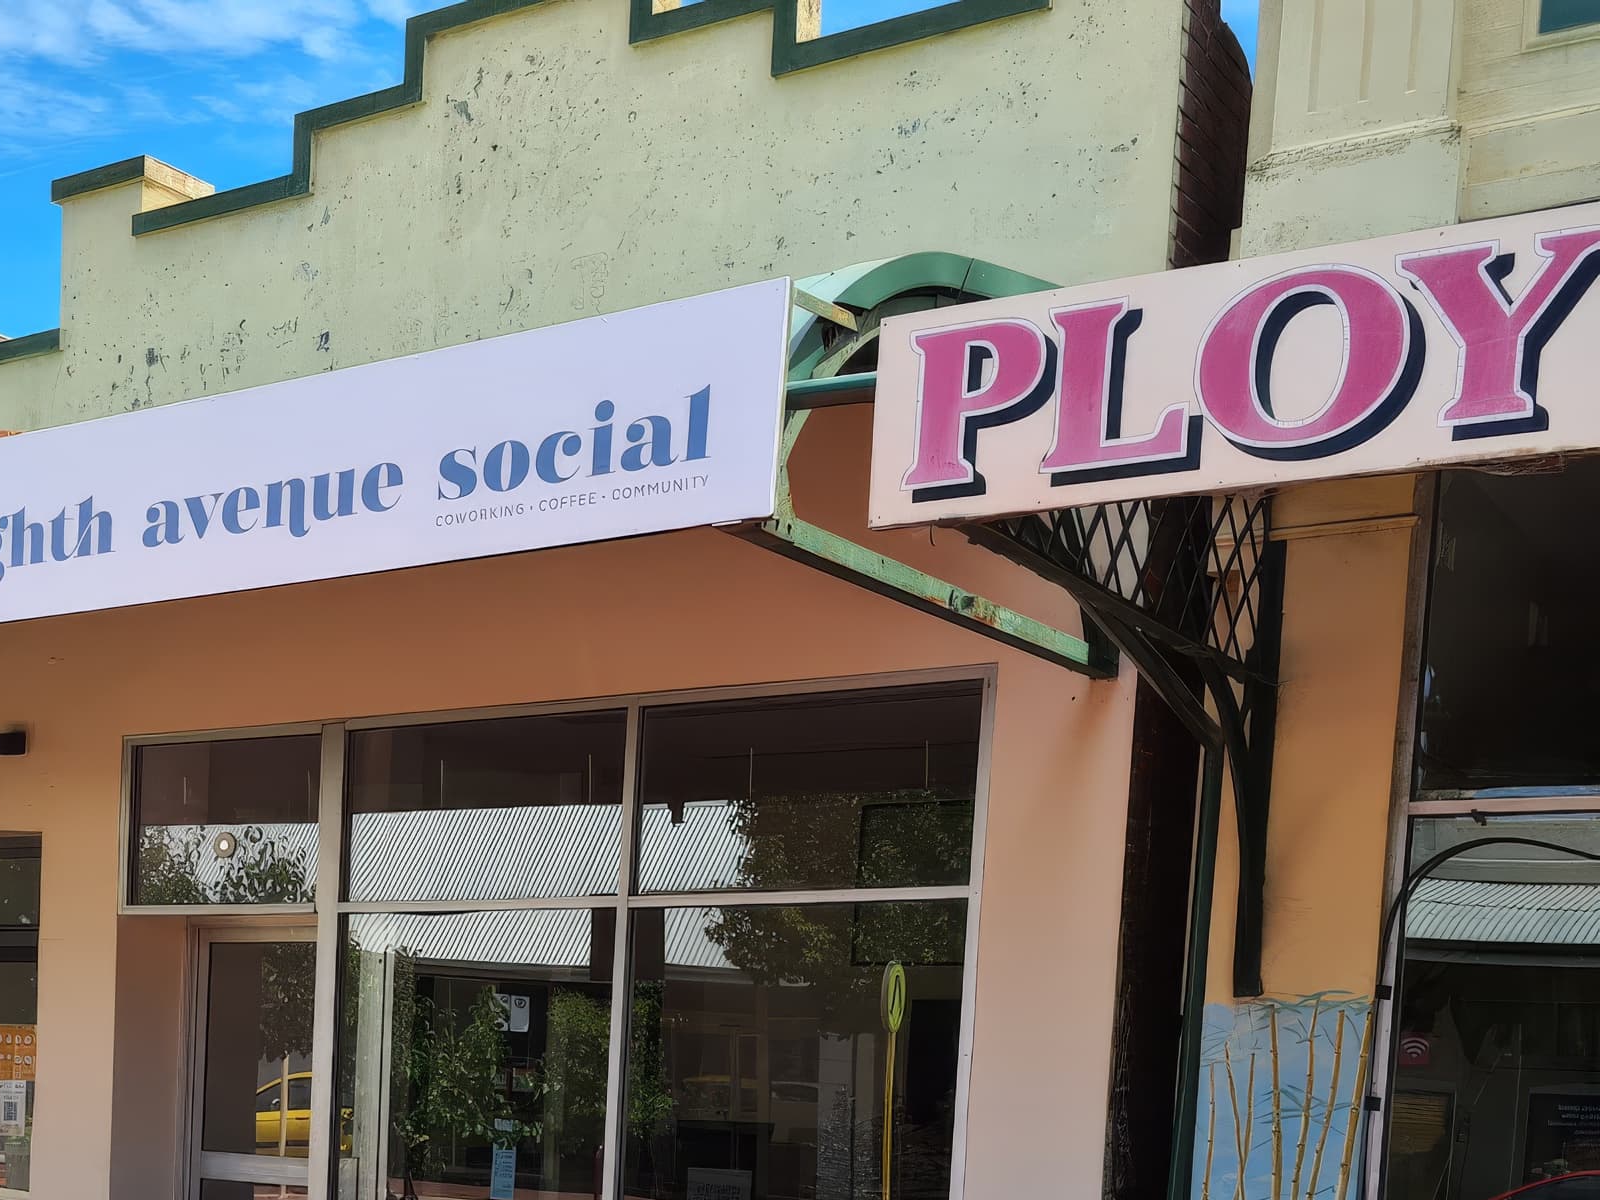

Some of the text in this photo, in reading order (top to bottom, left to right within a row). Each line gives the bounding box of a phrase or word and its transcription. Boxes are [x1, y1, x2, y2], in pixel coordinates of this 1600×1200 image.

[900, 225, 1600, 504] PLOY
[141, 461, 405, 548] avenue
[436, 383, 713, 502] social
[434, 474, 710, 528] COWORKING COFFEE COMMUNITY
